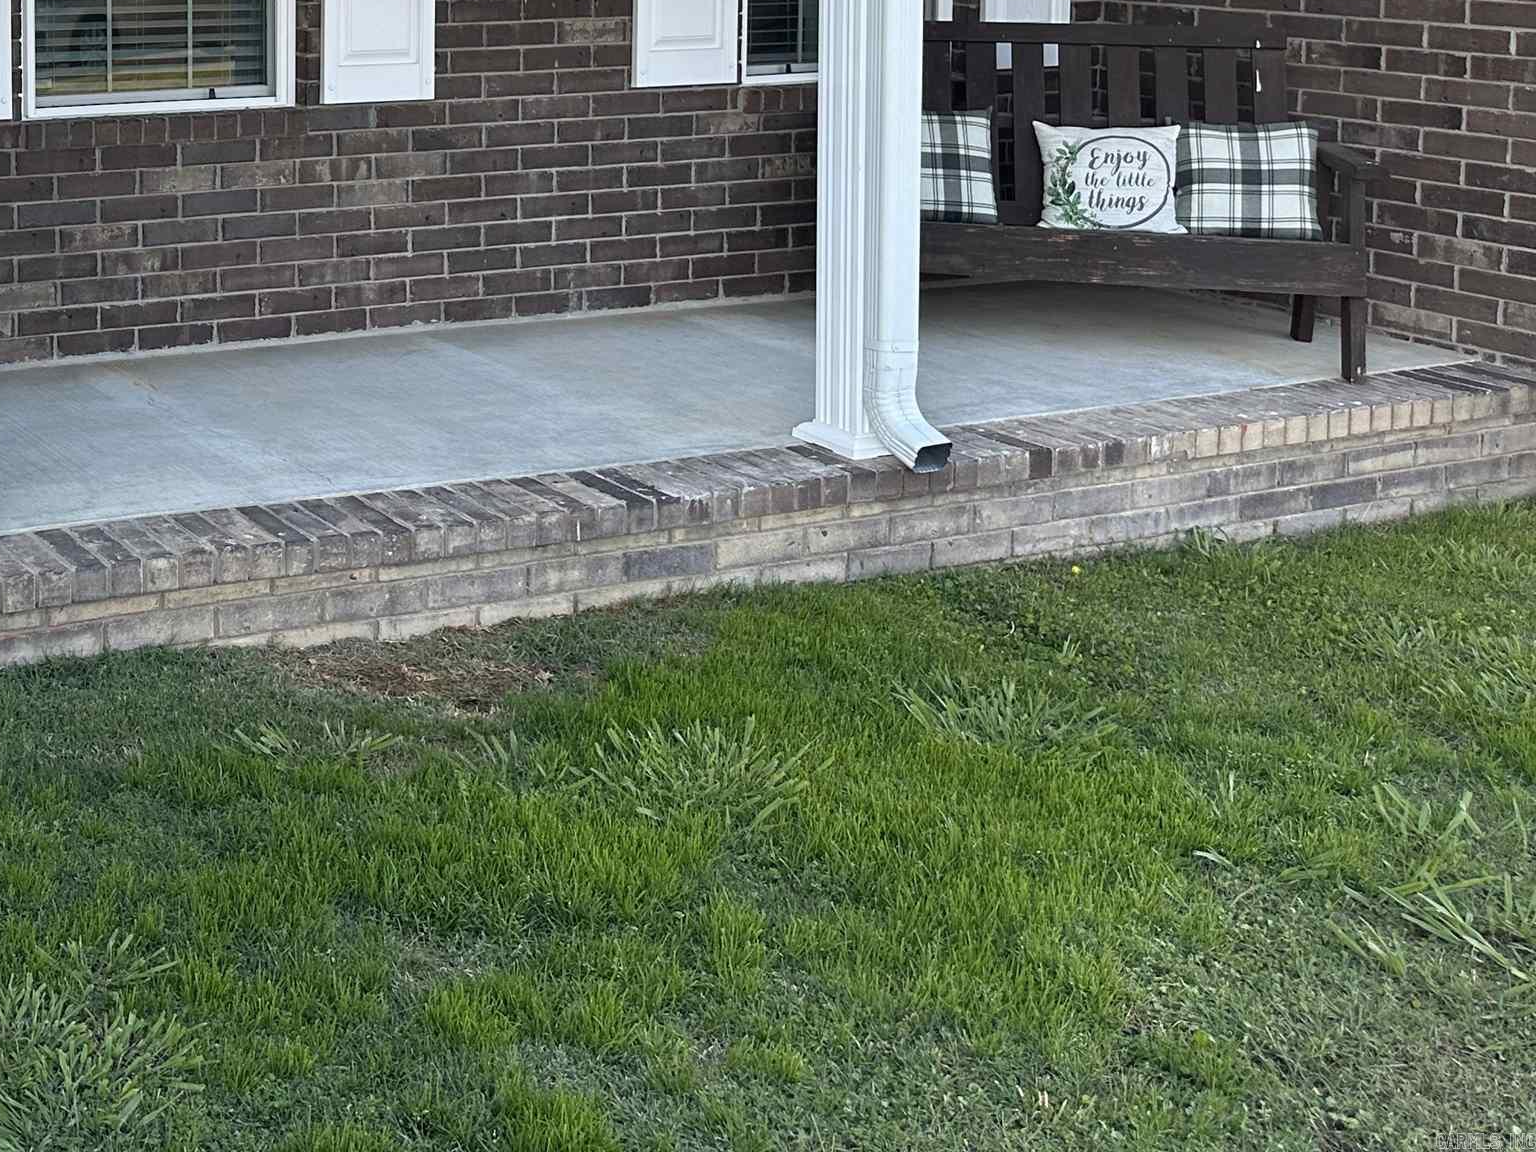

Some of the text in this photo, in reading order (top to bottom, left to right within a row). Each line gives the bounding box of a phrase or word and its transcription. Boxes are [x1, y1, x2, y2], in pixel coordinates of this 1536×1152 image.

[1088, 147, 1151, 177] Enjoy
[1084, 170, 1155, 189] the little
[1088, 188, 1148, 215] things
